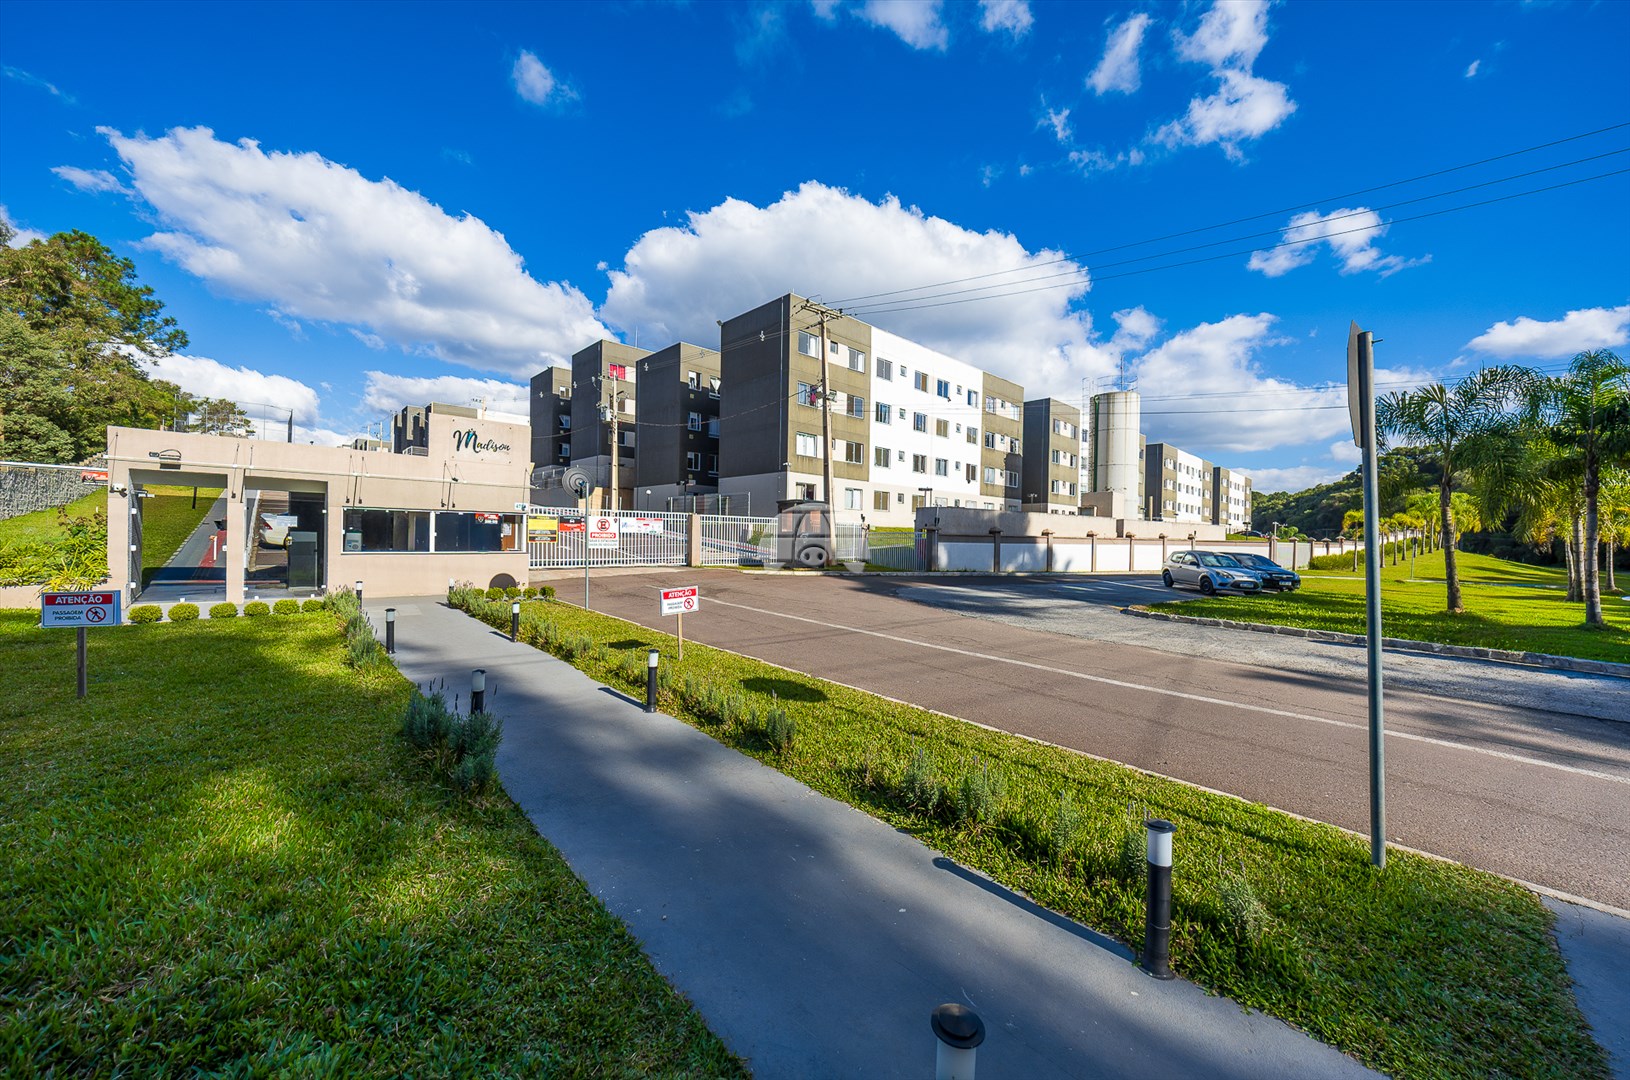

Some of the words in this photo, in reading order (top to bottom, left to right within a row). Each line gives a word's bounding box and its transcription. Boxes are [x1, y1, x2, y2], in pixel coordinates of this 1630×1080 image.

[452, 429, 511, 453] Madison
[55, 594, 103, 605] ATENÇÃO
[668, 589, 693, 599] ATENÇÃO
